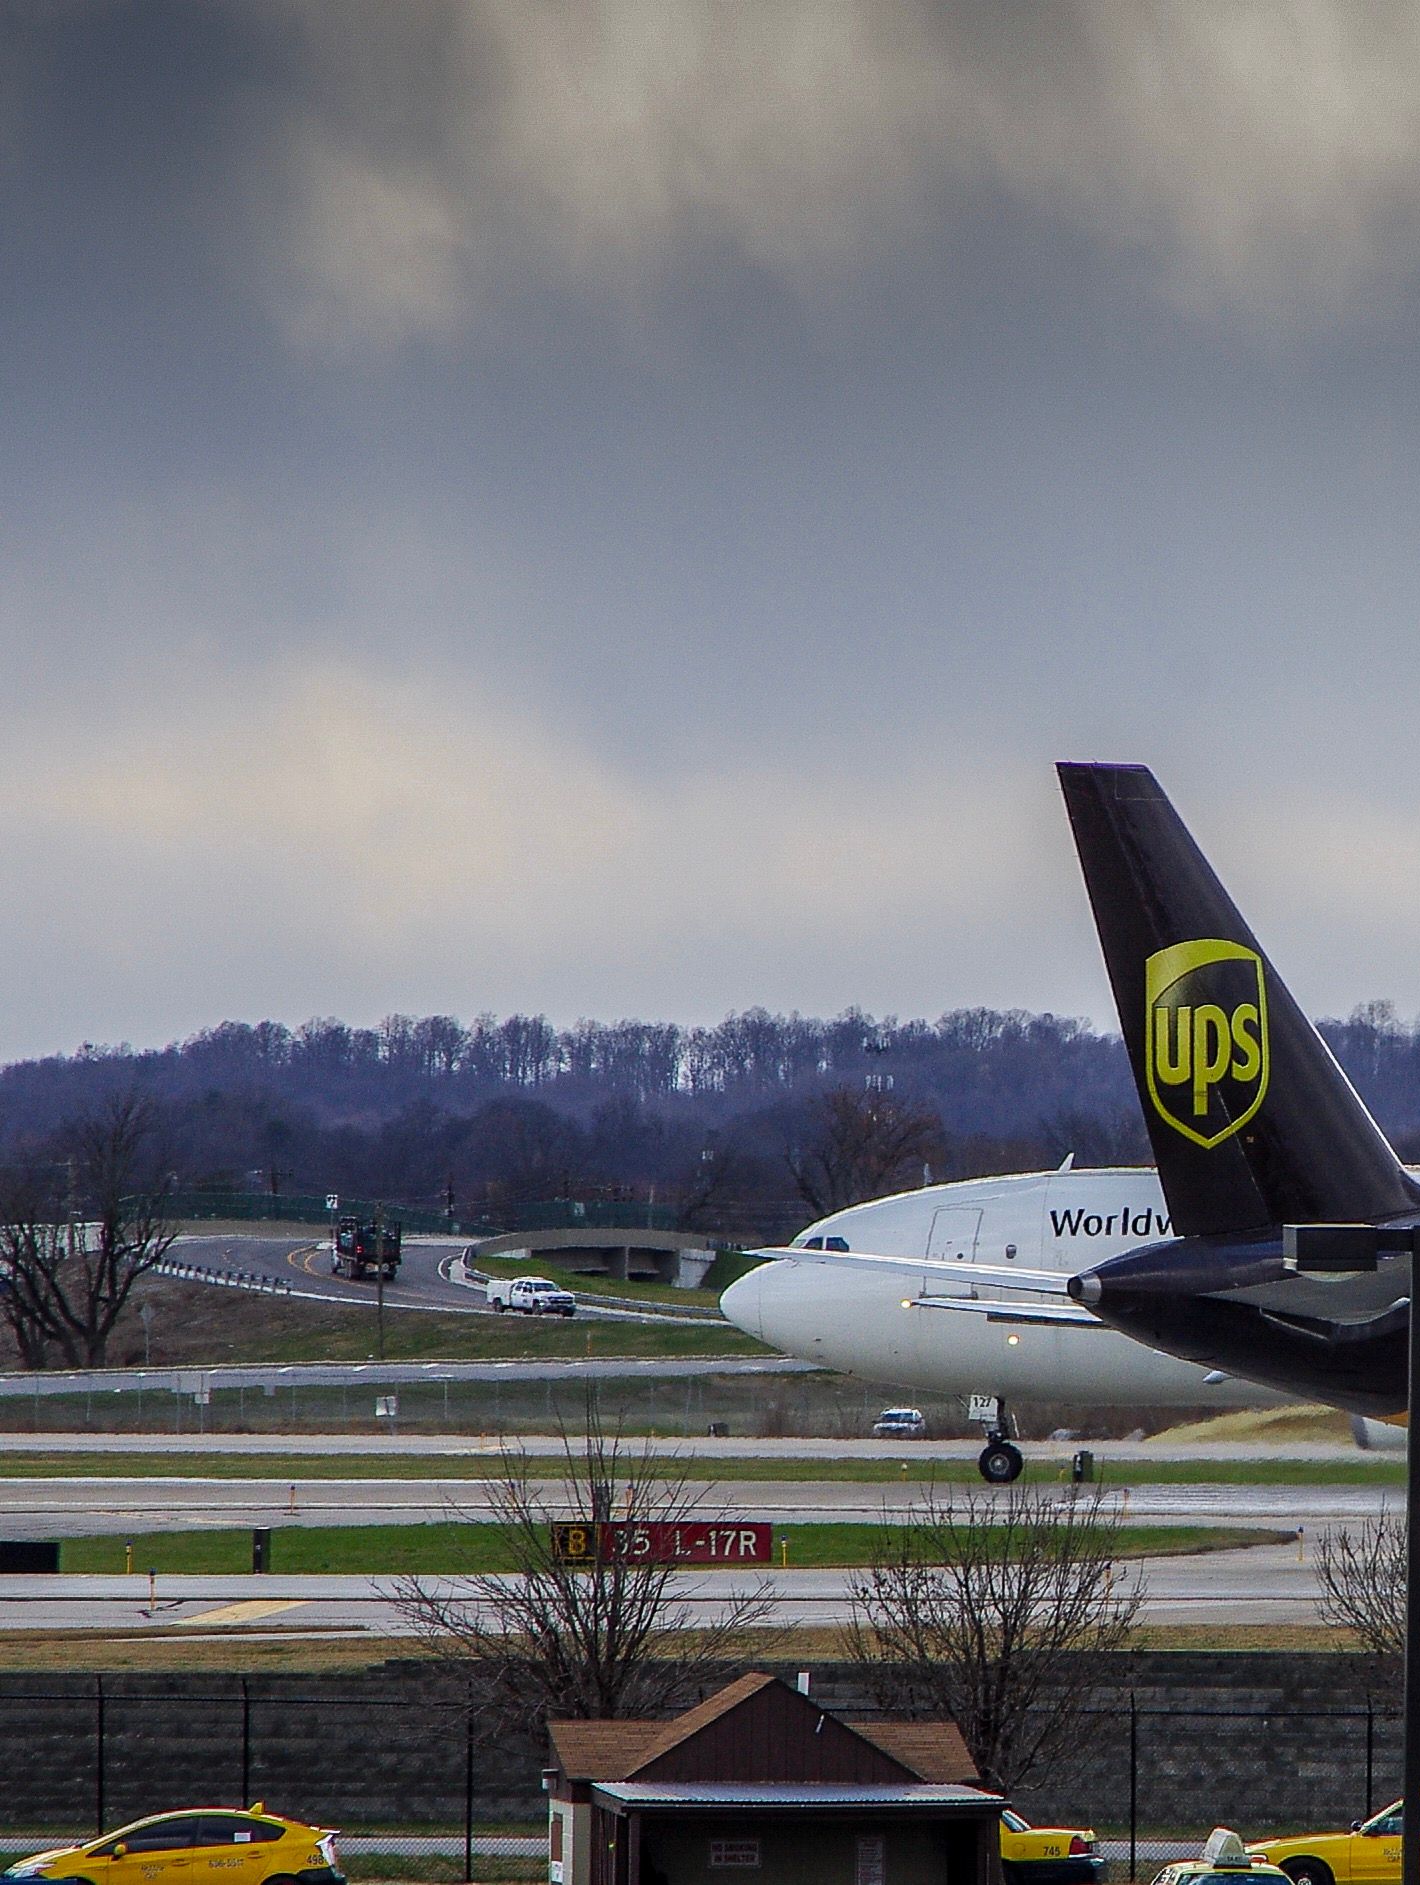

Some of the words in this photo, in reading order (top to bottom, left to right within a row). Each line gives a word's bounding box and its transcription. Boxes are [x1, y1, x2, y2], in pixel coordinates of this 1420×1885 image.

[974, 1396, 991, 1408] 127
[568, 1529, 586, 1554] B
[1043, 1846, 1060, 1856] 745
